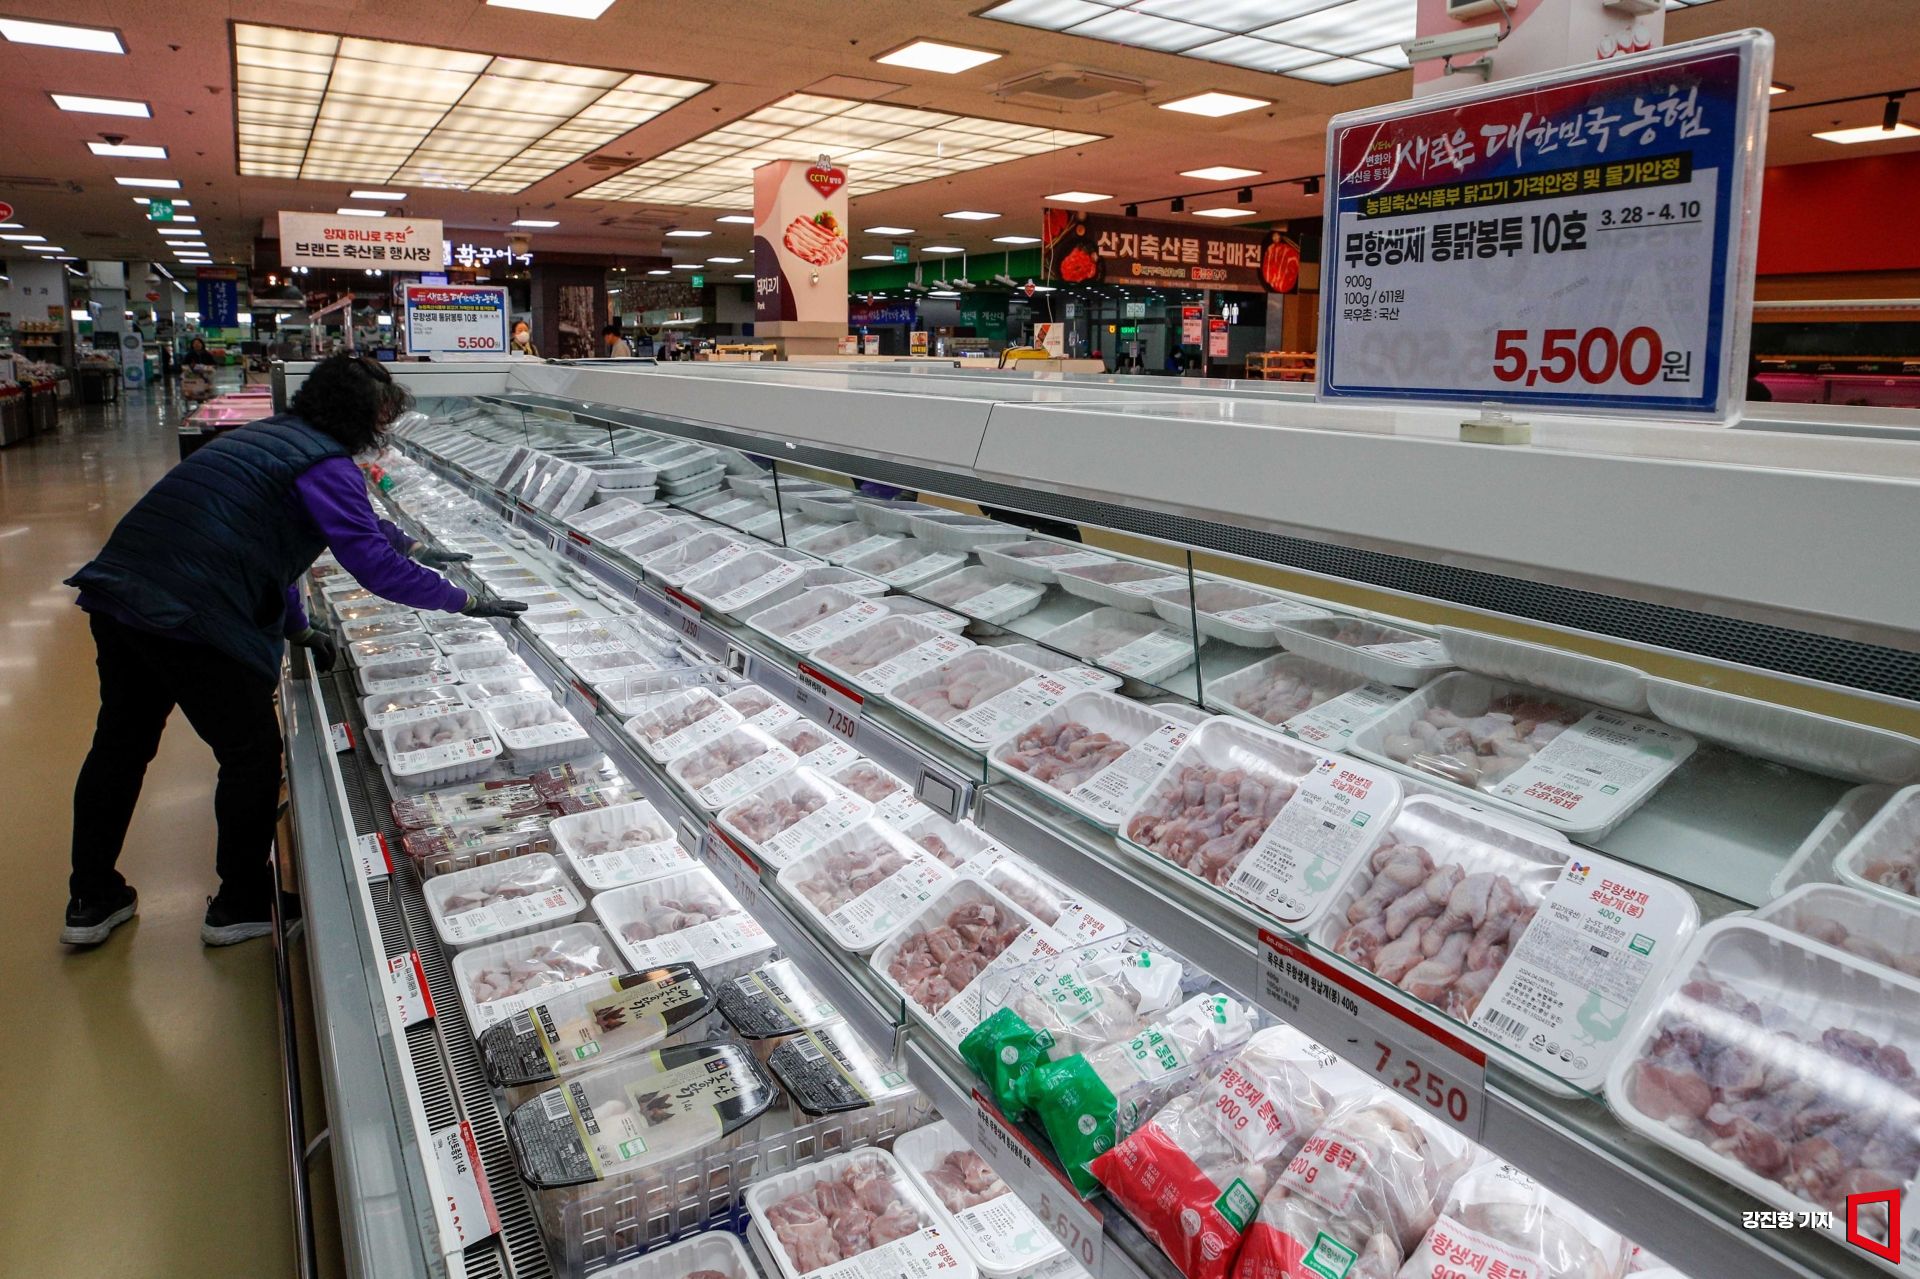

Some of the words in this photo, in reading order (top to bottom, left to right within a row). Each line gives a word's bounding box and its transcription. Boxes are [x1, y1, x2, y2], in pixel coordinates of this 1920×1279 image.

[1399, 128, 1475, 180] 새로운
[1480, 107, 1621, 169] 대한민국
[1619, 84, 1711, 145] 농협
[810, 173, 829, 182] CCTV
[1367, 188, 1460, 216] 농림축산식품부
[1464, 181, 1509, 204] 닭고기
[1513, 171, 1578, 197] 가격안정
[1584, 168, 1600, 188] 및
[1605, 158, 1681, 187] 물가안정
[295, 243, 340, 257] 브랜드
[343, 245, 386, 260] 축산물
[390, 247, 431, 262] 행사장
[1097, 231, 1199, 264] 산지축산물
[1207, 240, 1262, 268] 판매전
[1345, 226, 1426, 268] 무항생제
[1431, 216, 1523, 262] 통닭봉투
[1531, 210, 1588, 254] 10호
[1344, 275, 1372, 290] 900g
[1344, 292, 1369, 307] 100g
[1378, 289, 1405, 304] 611원
[464, 313, 477, 322] 10호
[1344, 308, 1372, 322] 목우촌
[1379, 307, 1400, 321] 국산
[827, 707, 855, 738] 7,250
[1339, 770, 1374, 789] 무항생제
[1589, 890, 1645, 919] 윗날개(봉)
[1600, 879, 1650, 906] 무항생제
[1597, 908, 1615, 920] 400
[1614, 916, 1623, 925] g
[1267, 951, 1285, 972] 목우촌
[1285, 960, 1310, 987] 무항생제
[1341, 998, 1359, 1017] 400g
[1155, 1044, 1178, 1071] 통닭
[1216, 1095, 1240, 1120] 900
[1234, 1115, 1249, 1130] g
[1217, 1068, 1265, 1108] 무항생제
[1257, 1100, 1283, 1136] 통닭
[1288, 1156, 1309, 1175] 900
[1304, 1164, 1319, 1184] g
[1324, 1139, 1357, 1173] 통닭
[935, 1243, 957, 1268] 무항생제
[1427, 1229, 1489, 1274] 항생제
